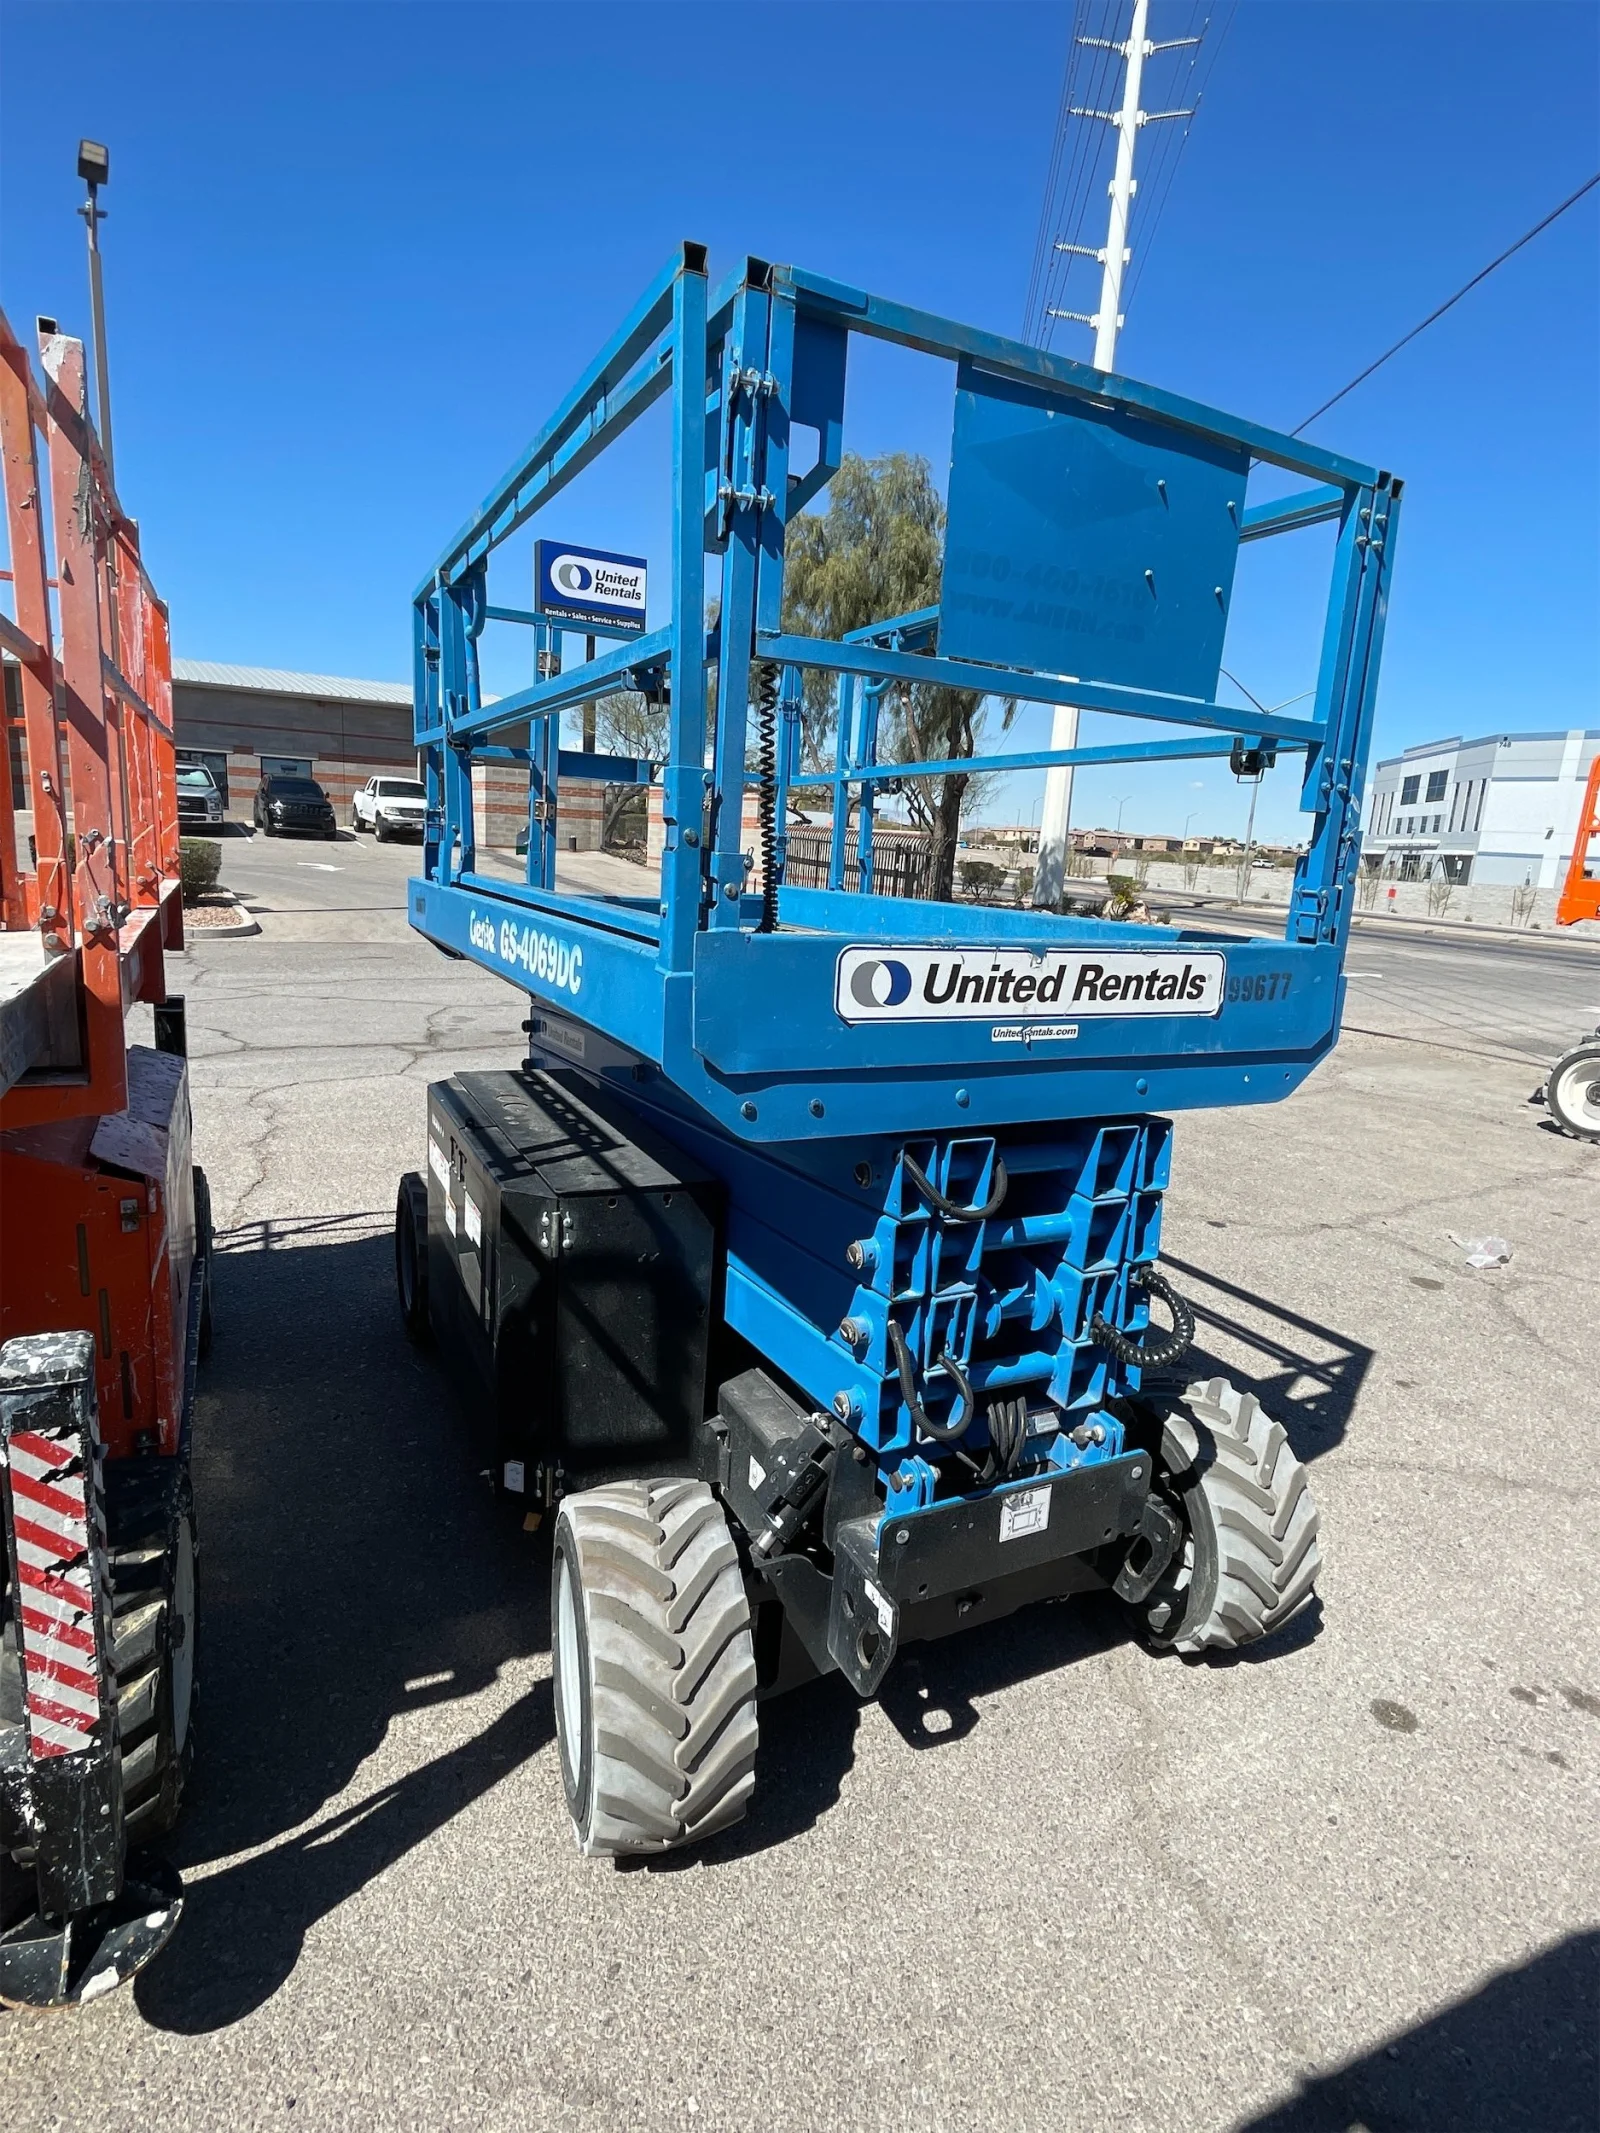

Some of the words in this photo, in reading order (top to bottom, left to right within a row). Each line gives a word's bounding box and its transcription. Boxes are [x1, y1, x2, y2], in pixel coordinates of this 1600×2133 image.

[595, 569, 639, 587] United
[594, 582, 642, 601] Rentals
[544, 608, 567, 618] Rentals
[572, 612, 587, 621] Sales
[591, 616, 612, 625] Service
[616, 620, 640, 629] Supplies
[500, 919, 583, 995] GS-4069DC
[923, 963, 1066, 1004] United
[1072, 963, 1208, 1001] Rentals
